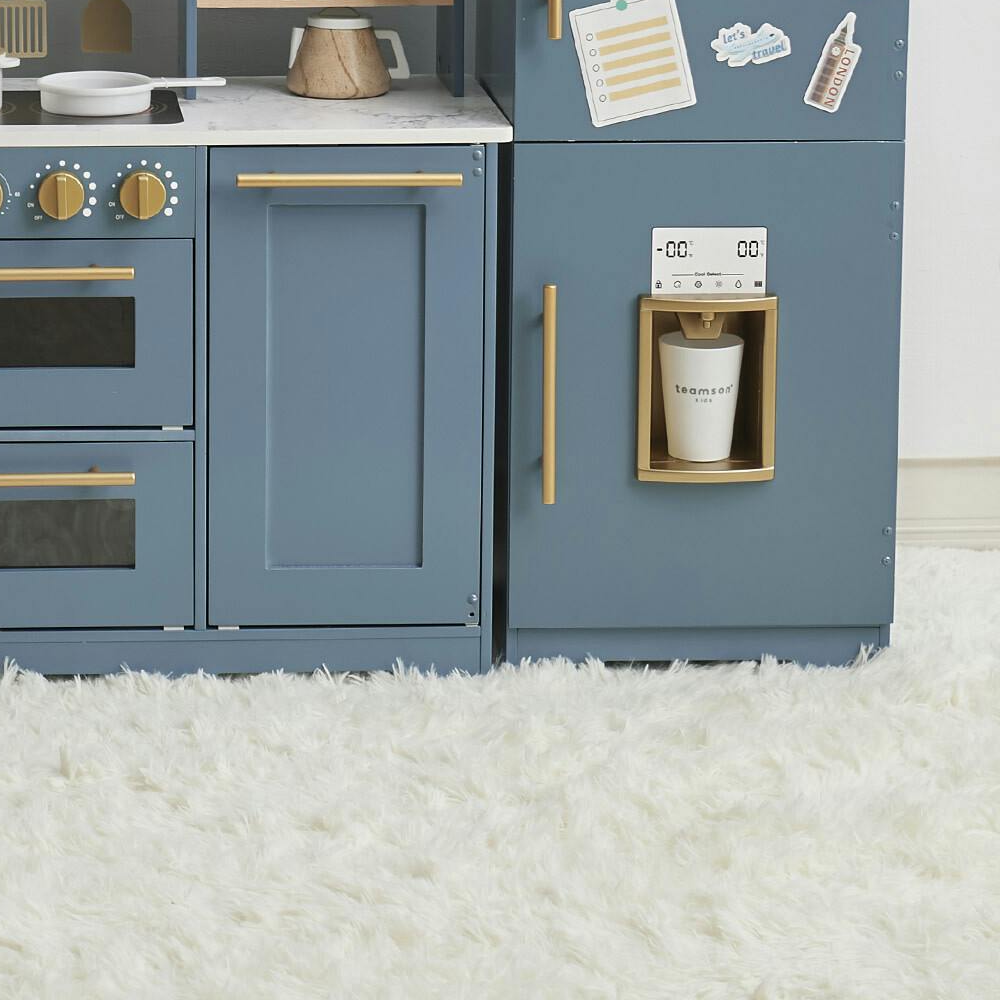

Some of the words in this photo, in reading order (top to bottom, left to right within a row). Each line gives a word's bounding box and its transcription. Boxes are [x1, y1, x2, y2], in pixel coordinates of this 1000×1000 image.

[722, 29, 745, 44] let's
[751, 39, 785, 60] travel
[824, 49, 855, 107] LONDON
[737, 240, 759, 258] 00
[675, 384, 731, 395] teamson
